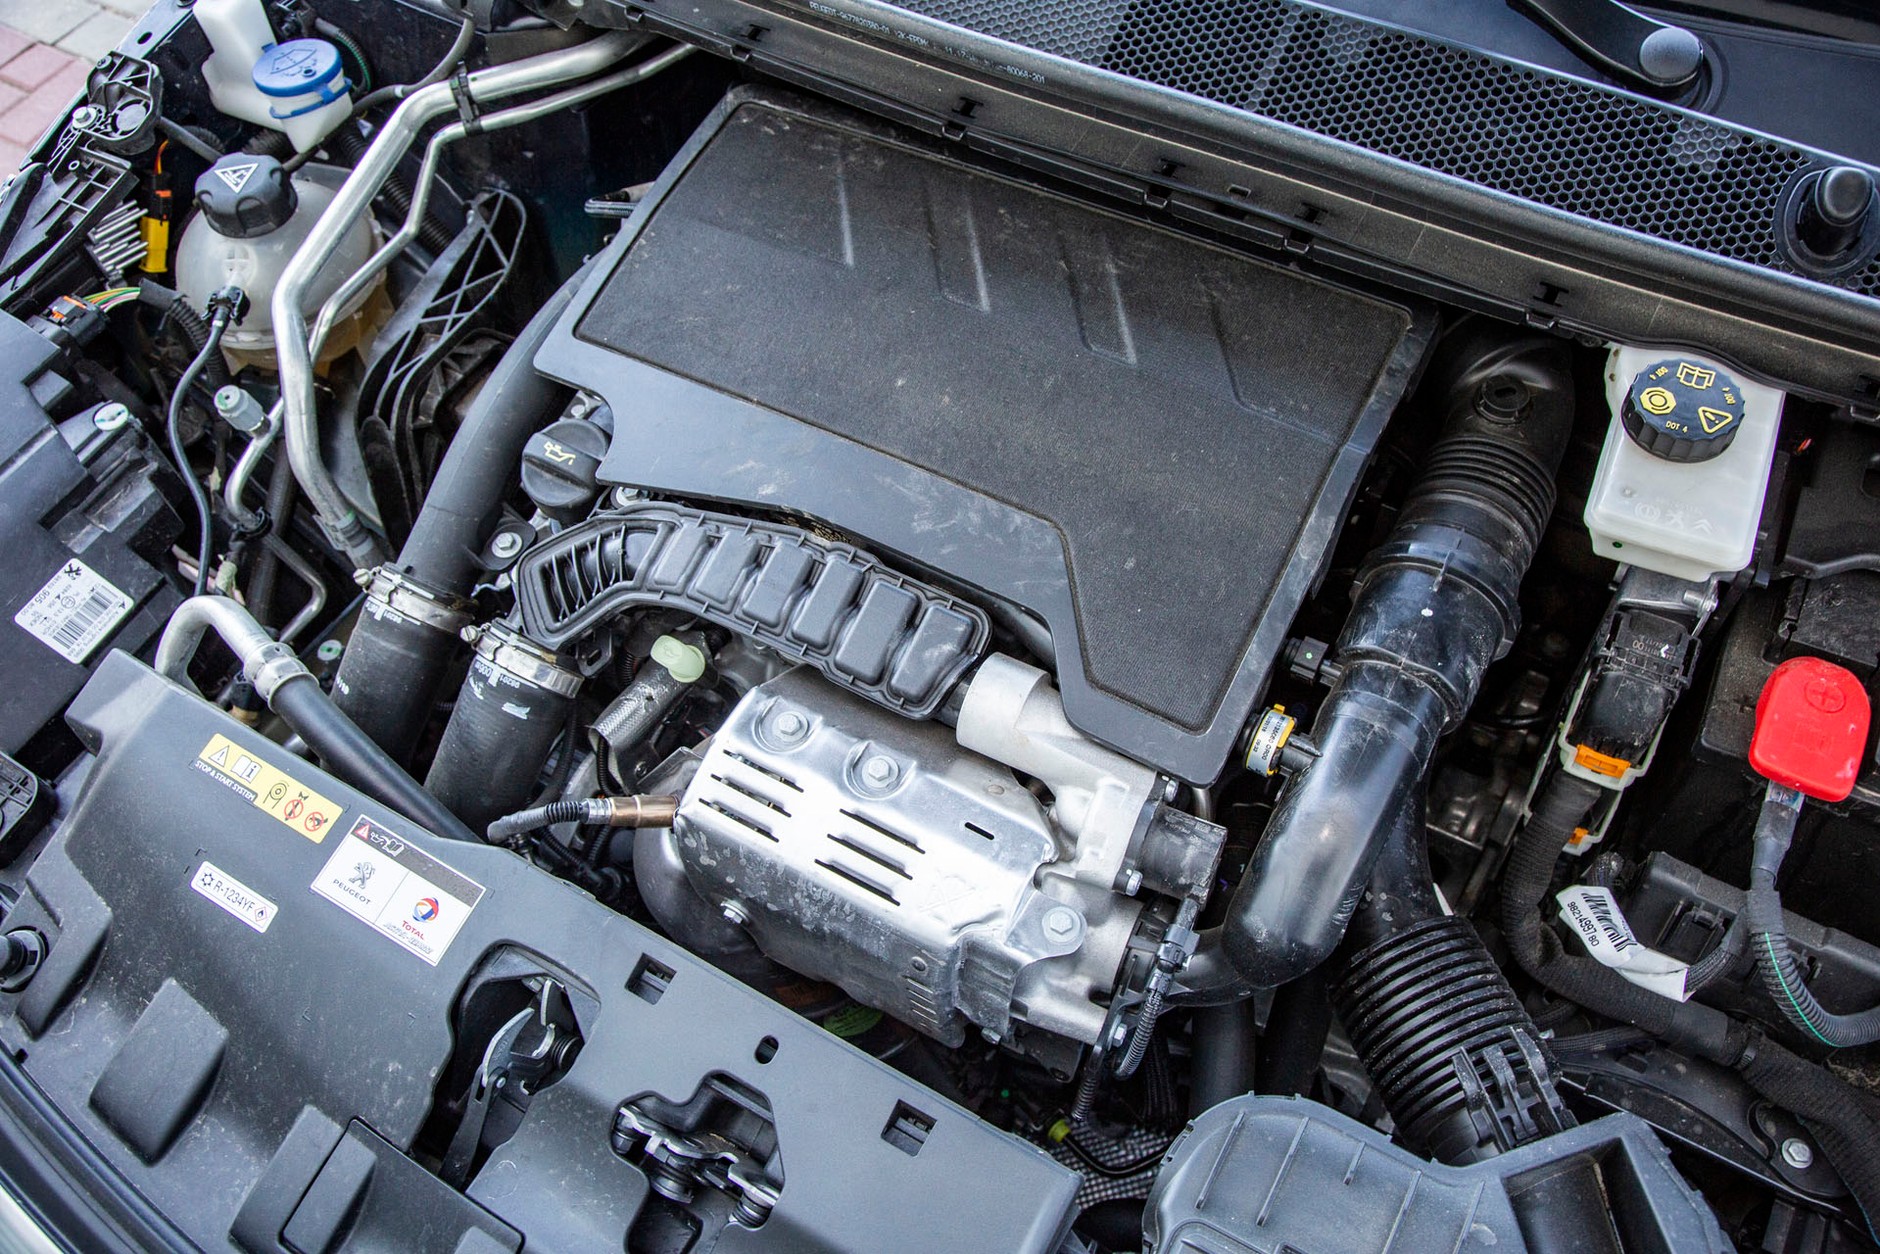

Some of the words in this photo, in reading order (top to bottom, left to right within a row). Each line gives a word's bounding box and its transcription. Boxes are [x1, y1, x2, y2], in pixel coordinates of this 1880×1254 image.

[1665, 420, 1680, 430] DOT
[1682, 425, 1688, 433] 4
[34, 590, 50, 604] 905
[195, 760, 211, 775] STOP
[214, 772, 234, 788] START
[232, 781, 256, 801] SYSTEM
[213, 880, 255, 912] R-1234YF
[332, 879, 372, 905] PEUGEOT
[401, 920, 425, 940] TOTAL
